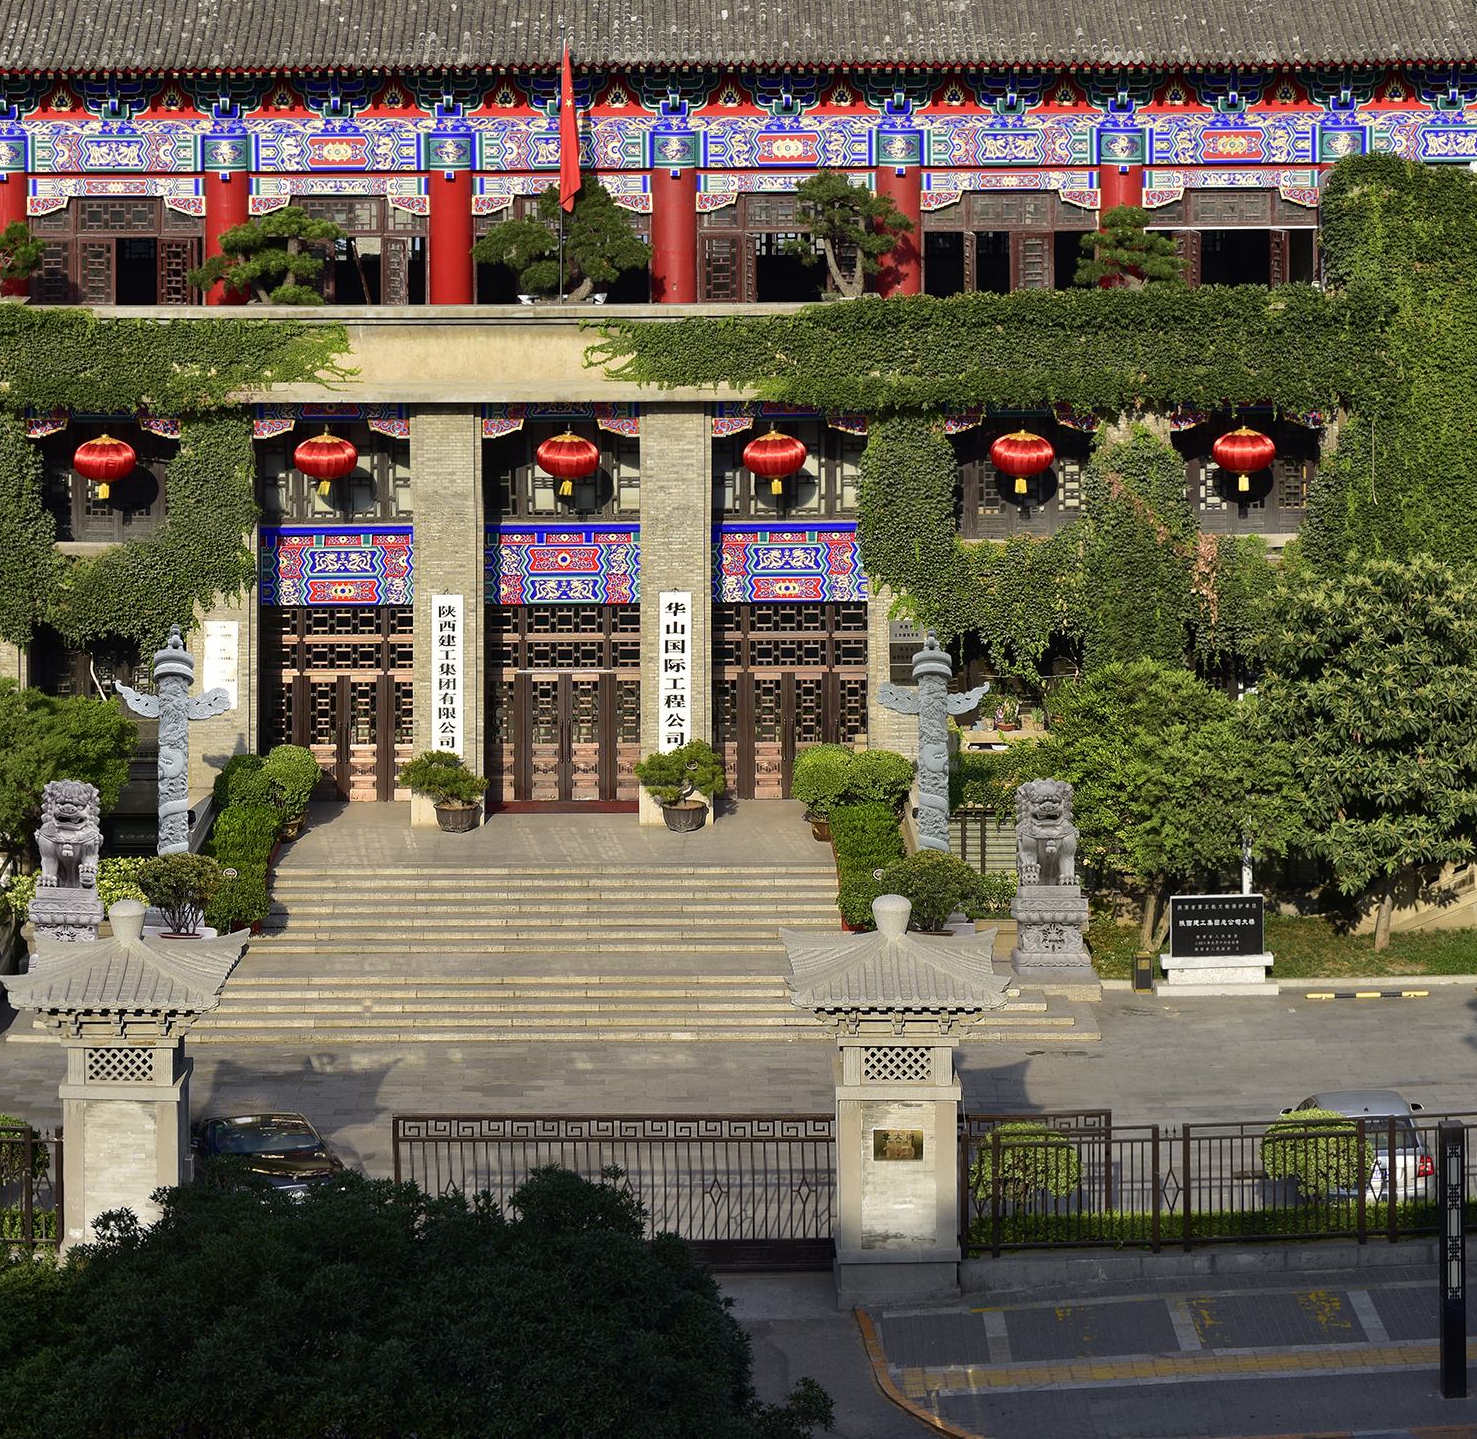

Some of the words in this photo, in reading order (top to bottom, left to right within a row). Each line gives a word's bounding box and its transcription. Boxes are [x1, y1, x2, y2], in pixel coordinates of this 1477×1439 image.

[438, 605, 457, 749] 陕西建工集团有限公司
[664, 602, 687, 747] 华山国际工程公司
[1177, 902, 1257, 911] 陕西省第五批文物保护单位
[1179, 918, 1256, 927] 陕西建工集团总公司大楼
[882, 1132, 916, 1142] 北大街
